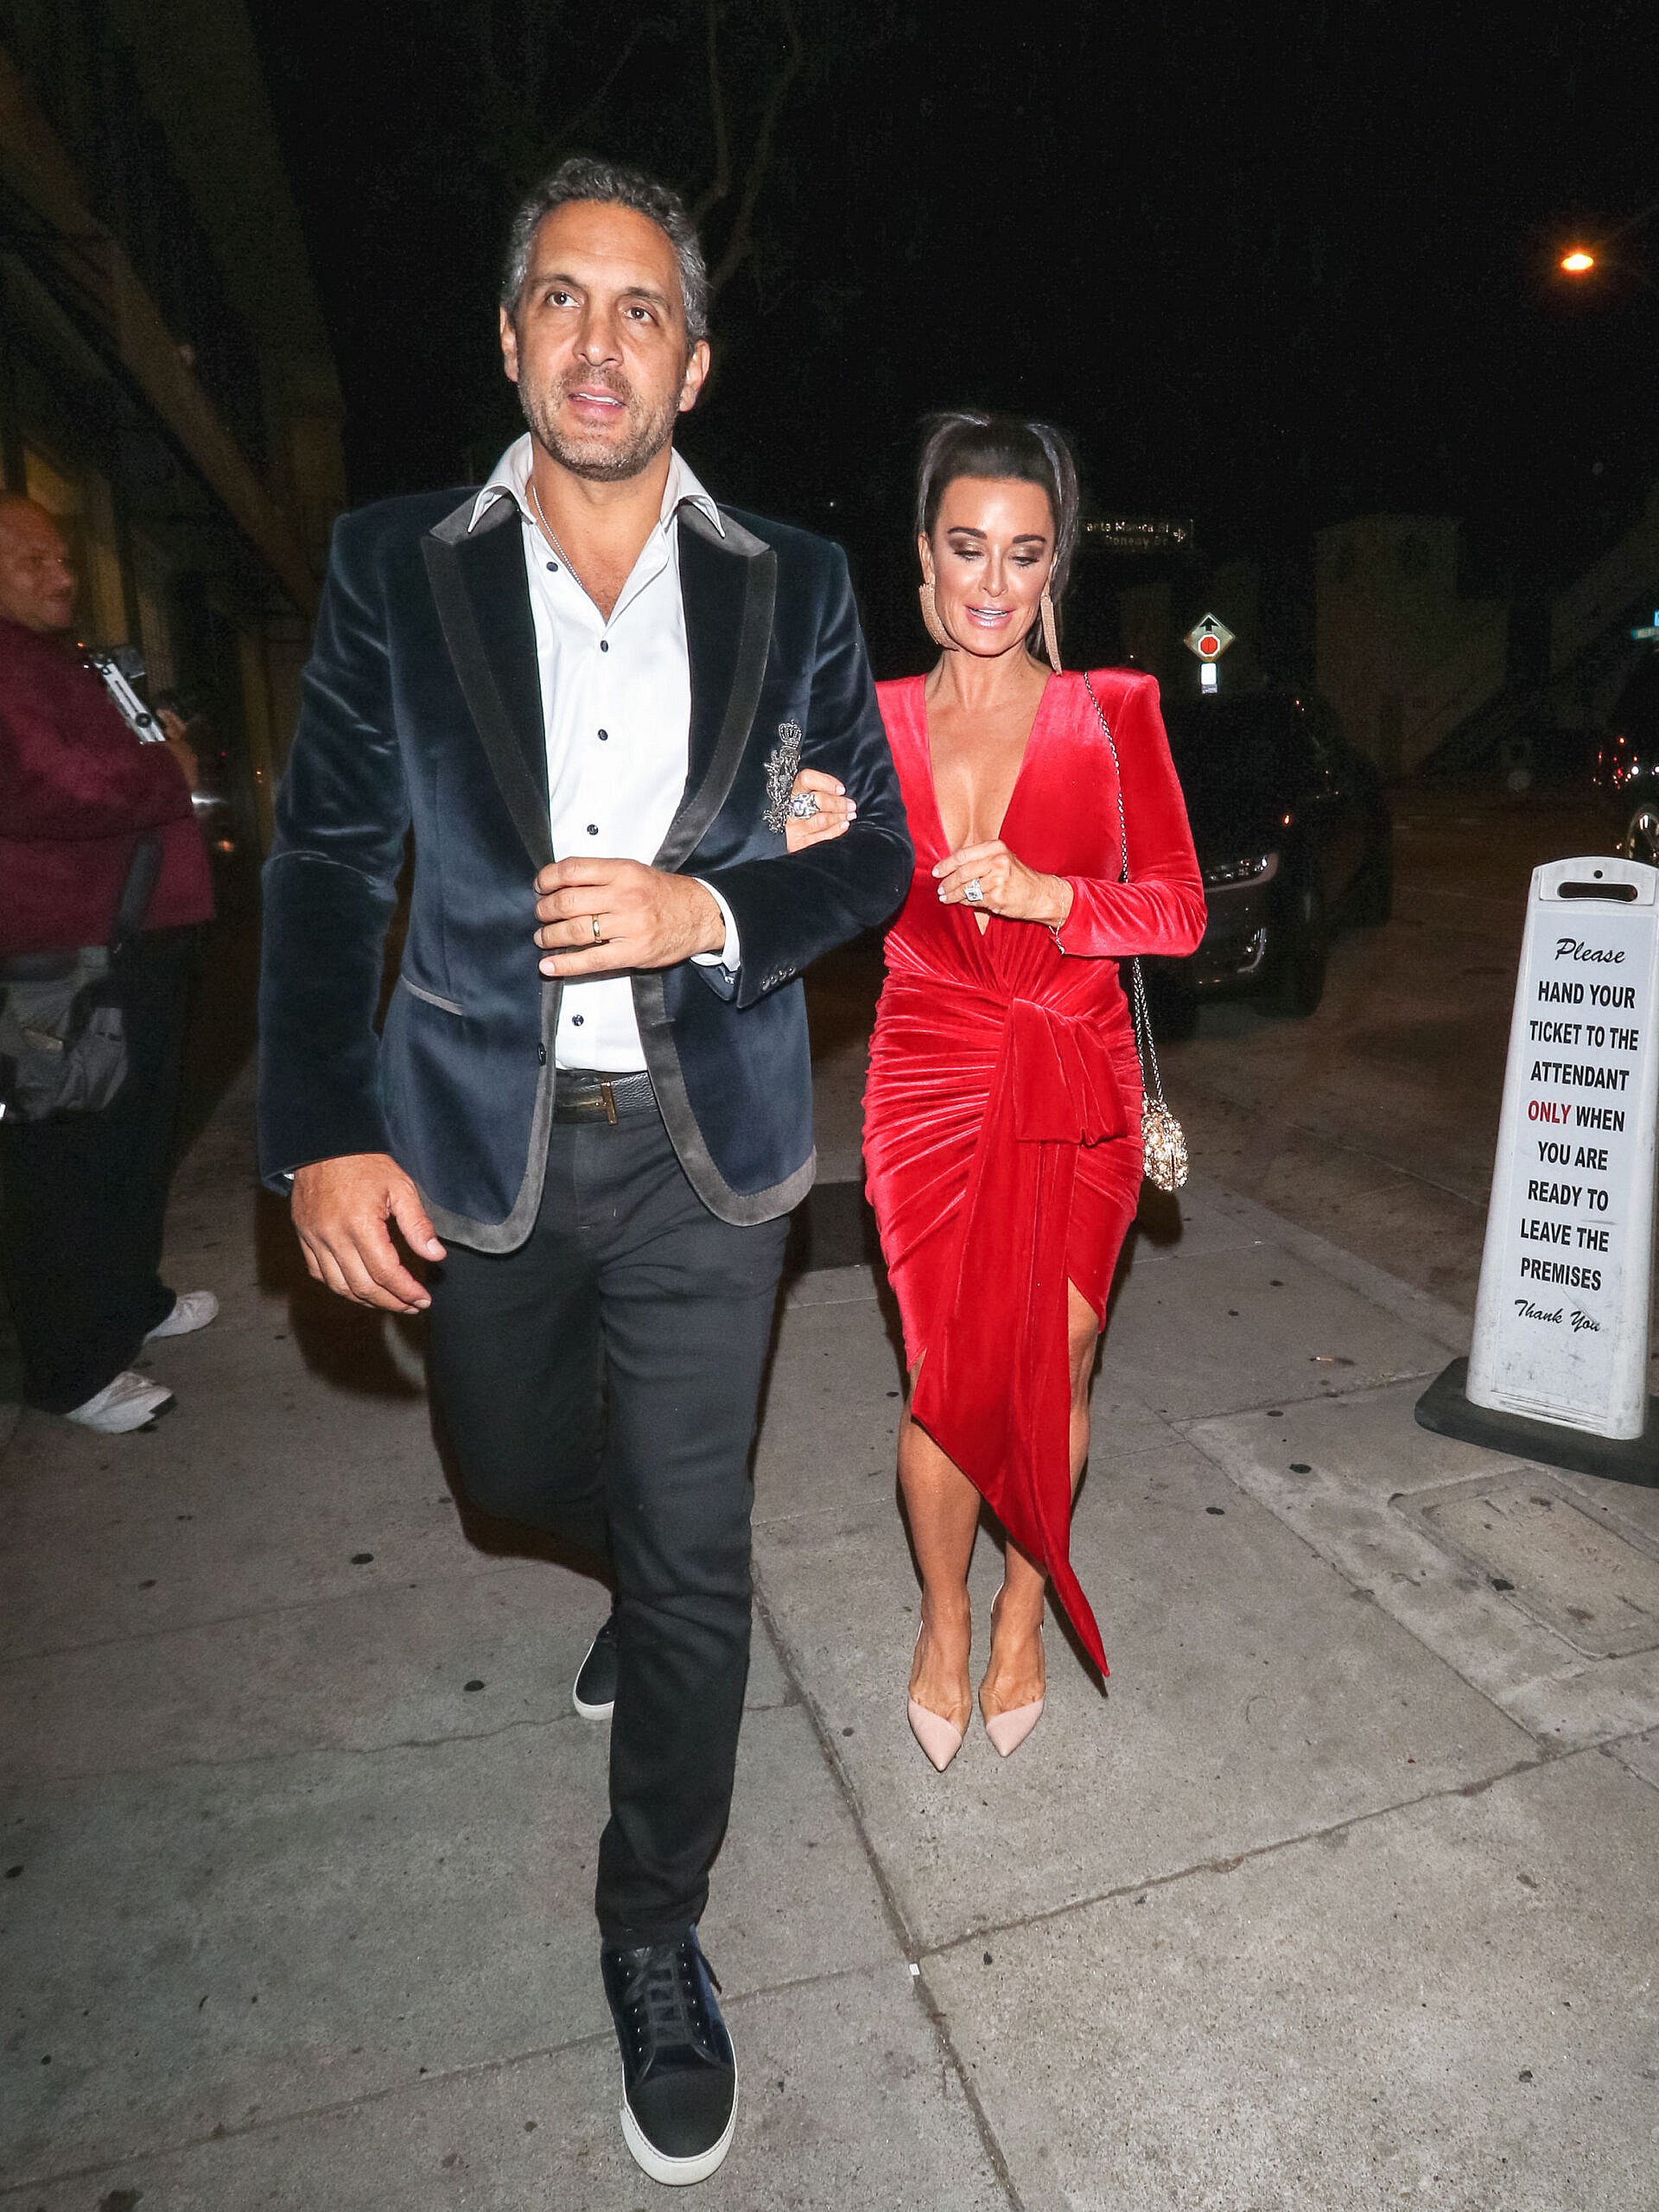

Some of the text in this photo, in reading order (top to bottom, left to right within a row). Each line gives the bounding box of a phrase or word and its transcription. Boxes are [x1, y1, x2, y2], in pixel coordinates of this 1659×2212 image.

[1555, 938, 1624, 963] Please
[1538, 981, 1635, 1008] HAND YOUR
[1530, 1020, 1638, 1051] TICKET TO THE
[1530, 1061, 1630, 1090] ATTENDANT
[1529, 1101, 1624, 1132] ONLY WHEN
[1538, 1141, 1608, 1170] YOU ARE
[1529, 1180, 1608, 1211] READY TO
[1521, 1218, 1609, 1252] LEAVE THE
[1521, 1257, 1601, 1291] PREMISES
[1515, 1300, 1599, 1332] Thank You
